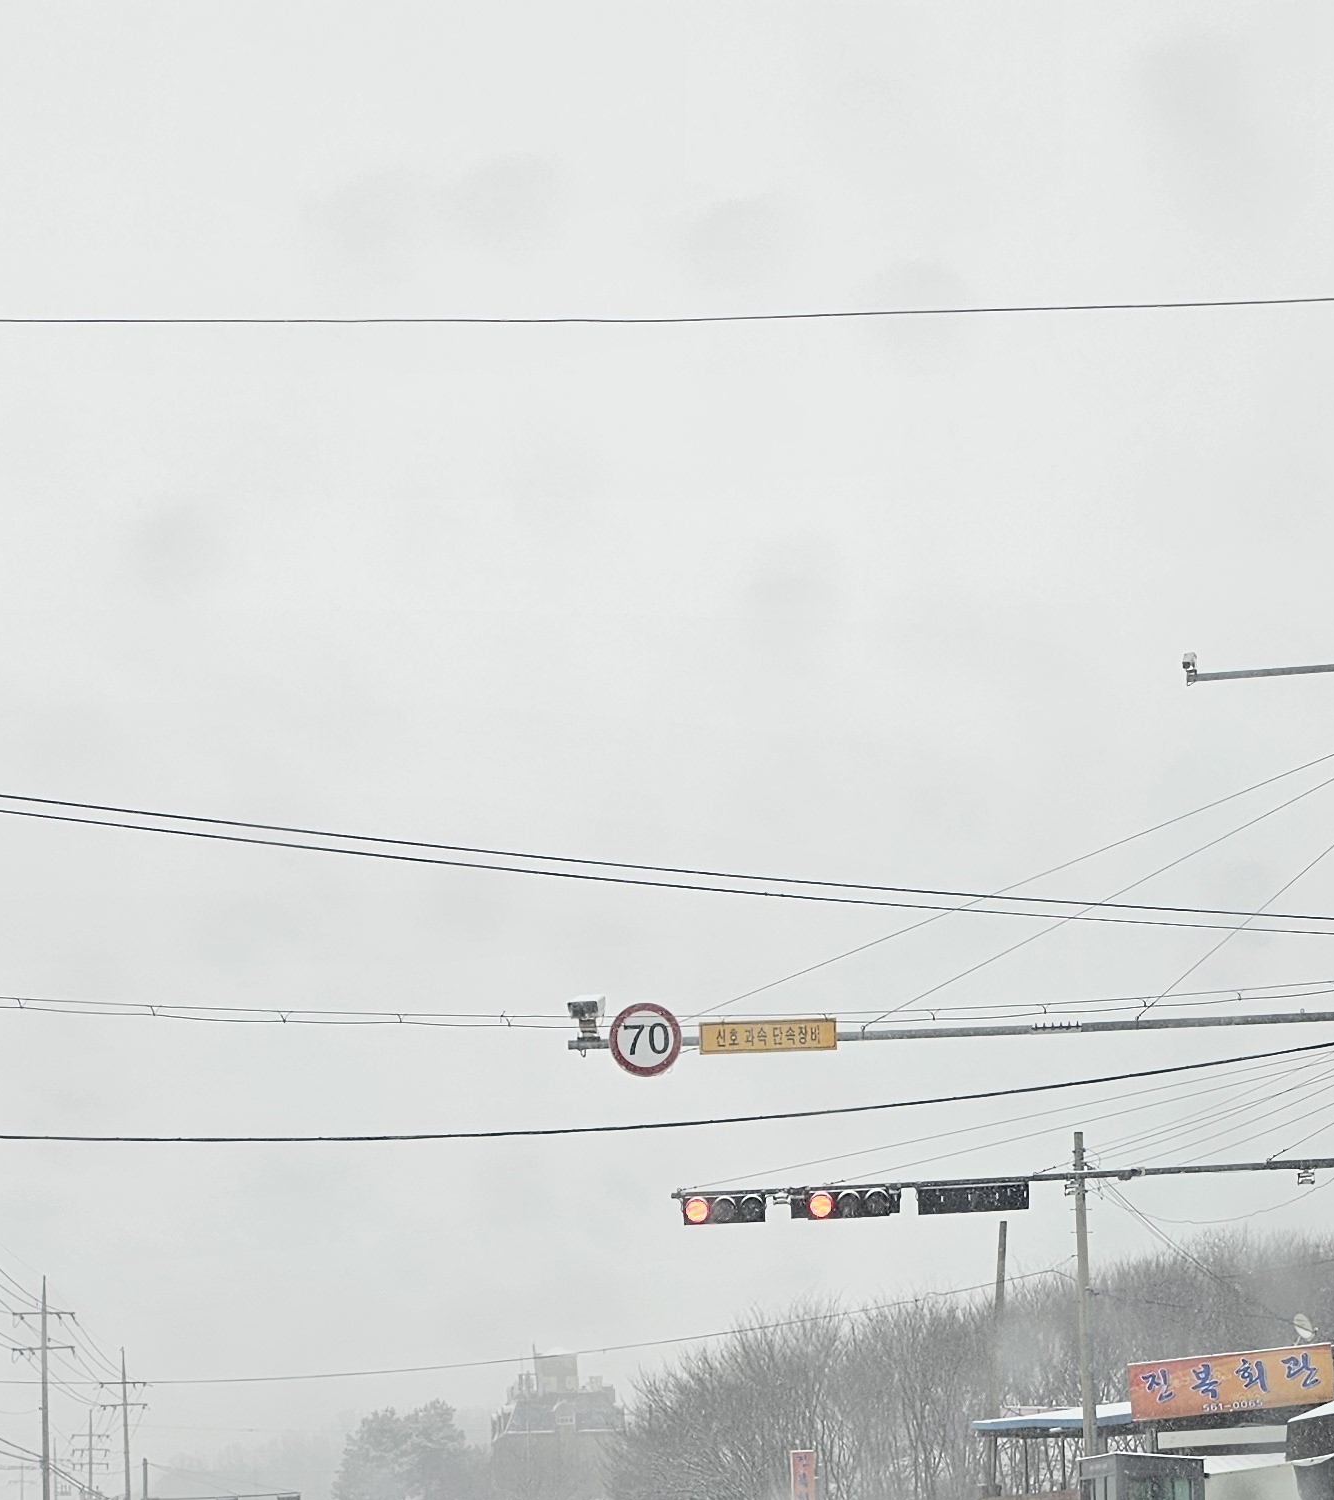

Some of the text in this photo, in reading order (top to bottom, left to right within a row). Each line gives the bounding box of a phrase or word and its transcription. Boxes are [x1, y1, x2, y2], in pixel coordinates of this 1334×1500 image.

[623, 1022, 669, 1056] 70
[716, 1024, 821, 1047] 신호 과속 단속장비
[1202, 1399, 1264, 1413] 561-0065
